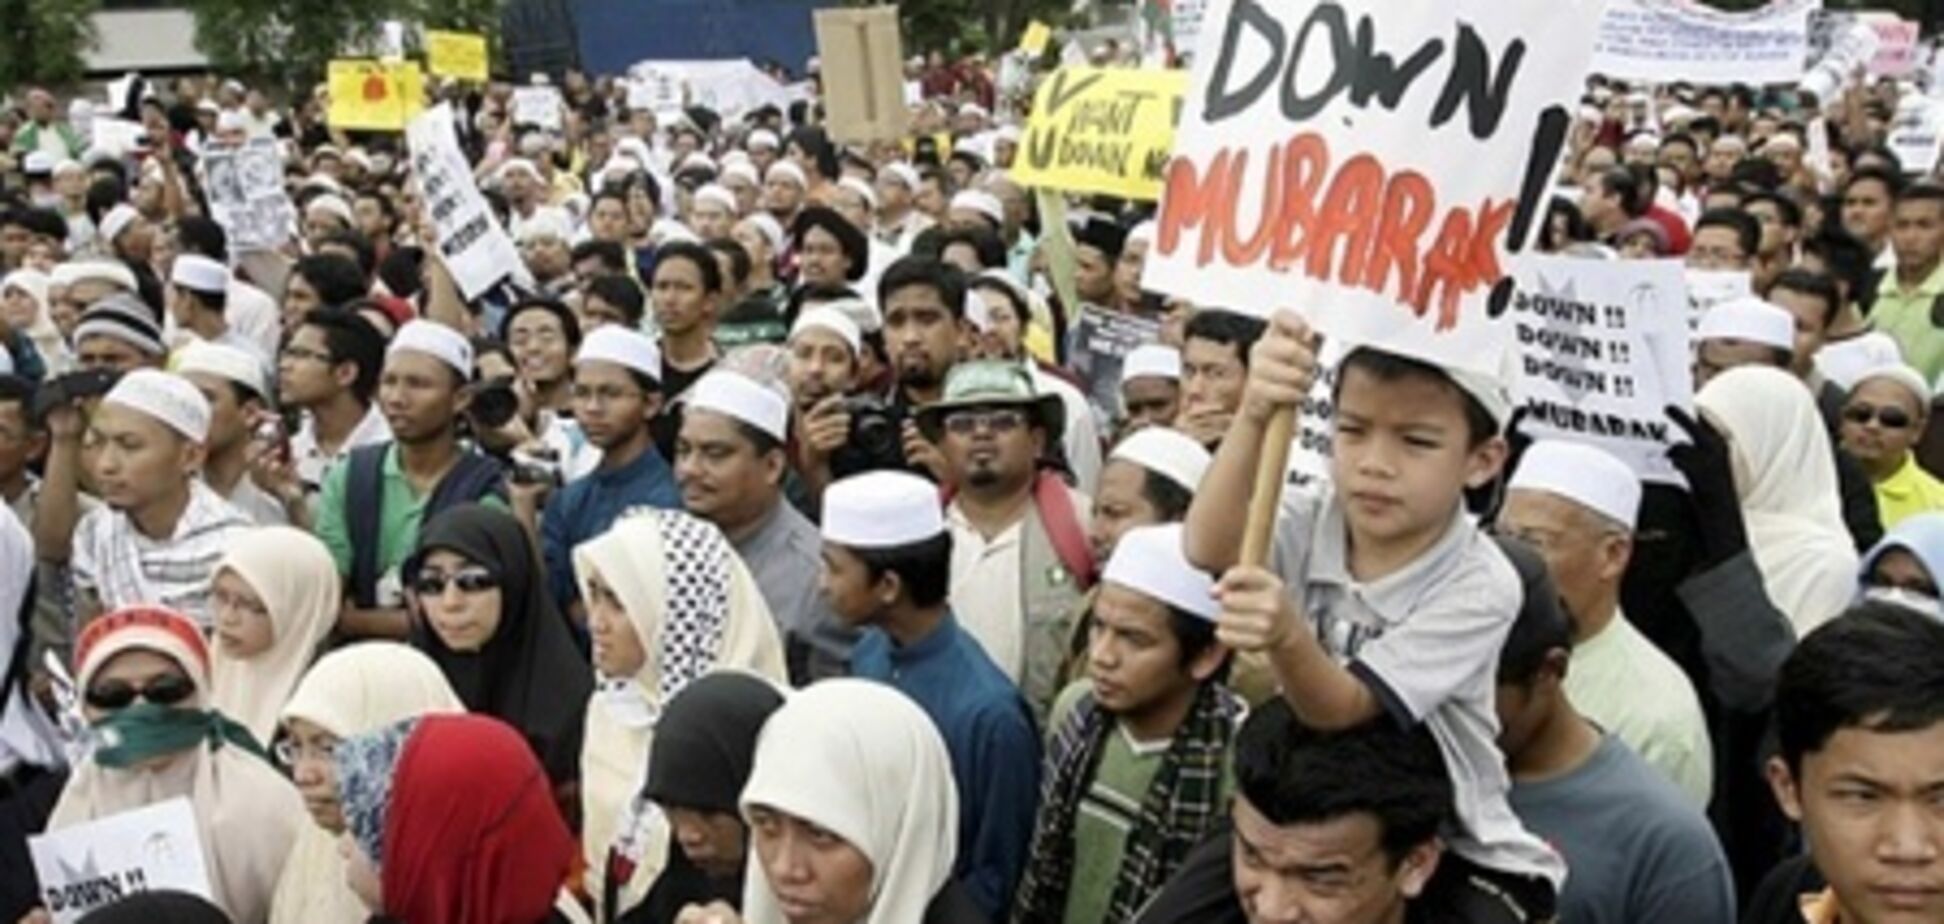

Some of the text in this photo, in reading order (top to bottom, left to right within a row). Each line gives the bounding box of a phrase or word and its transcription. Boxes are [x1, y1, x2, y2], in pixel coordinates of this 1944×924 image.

[1203, 0, 1527, 138] DOWN
[1514, 292, 1596, 325] DOWN
[1516, 323, 1602, 359] DOWN
[1523, 354, 1606, 394] DOWN
[47, 874, 123, 912] DOWN
